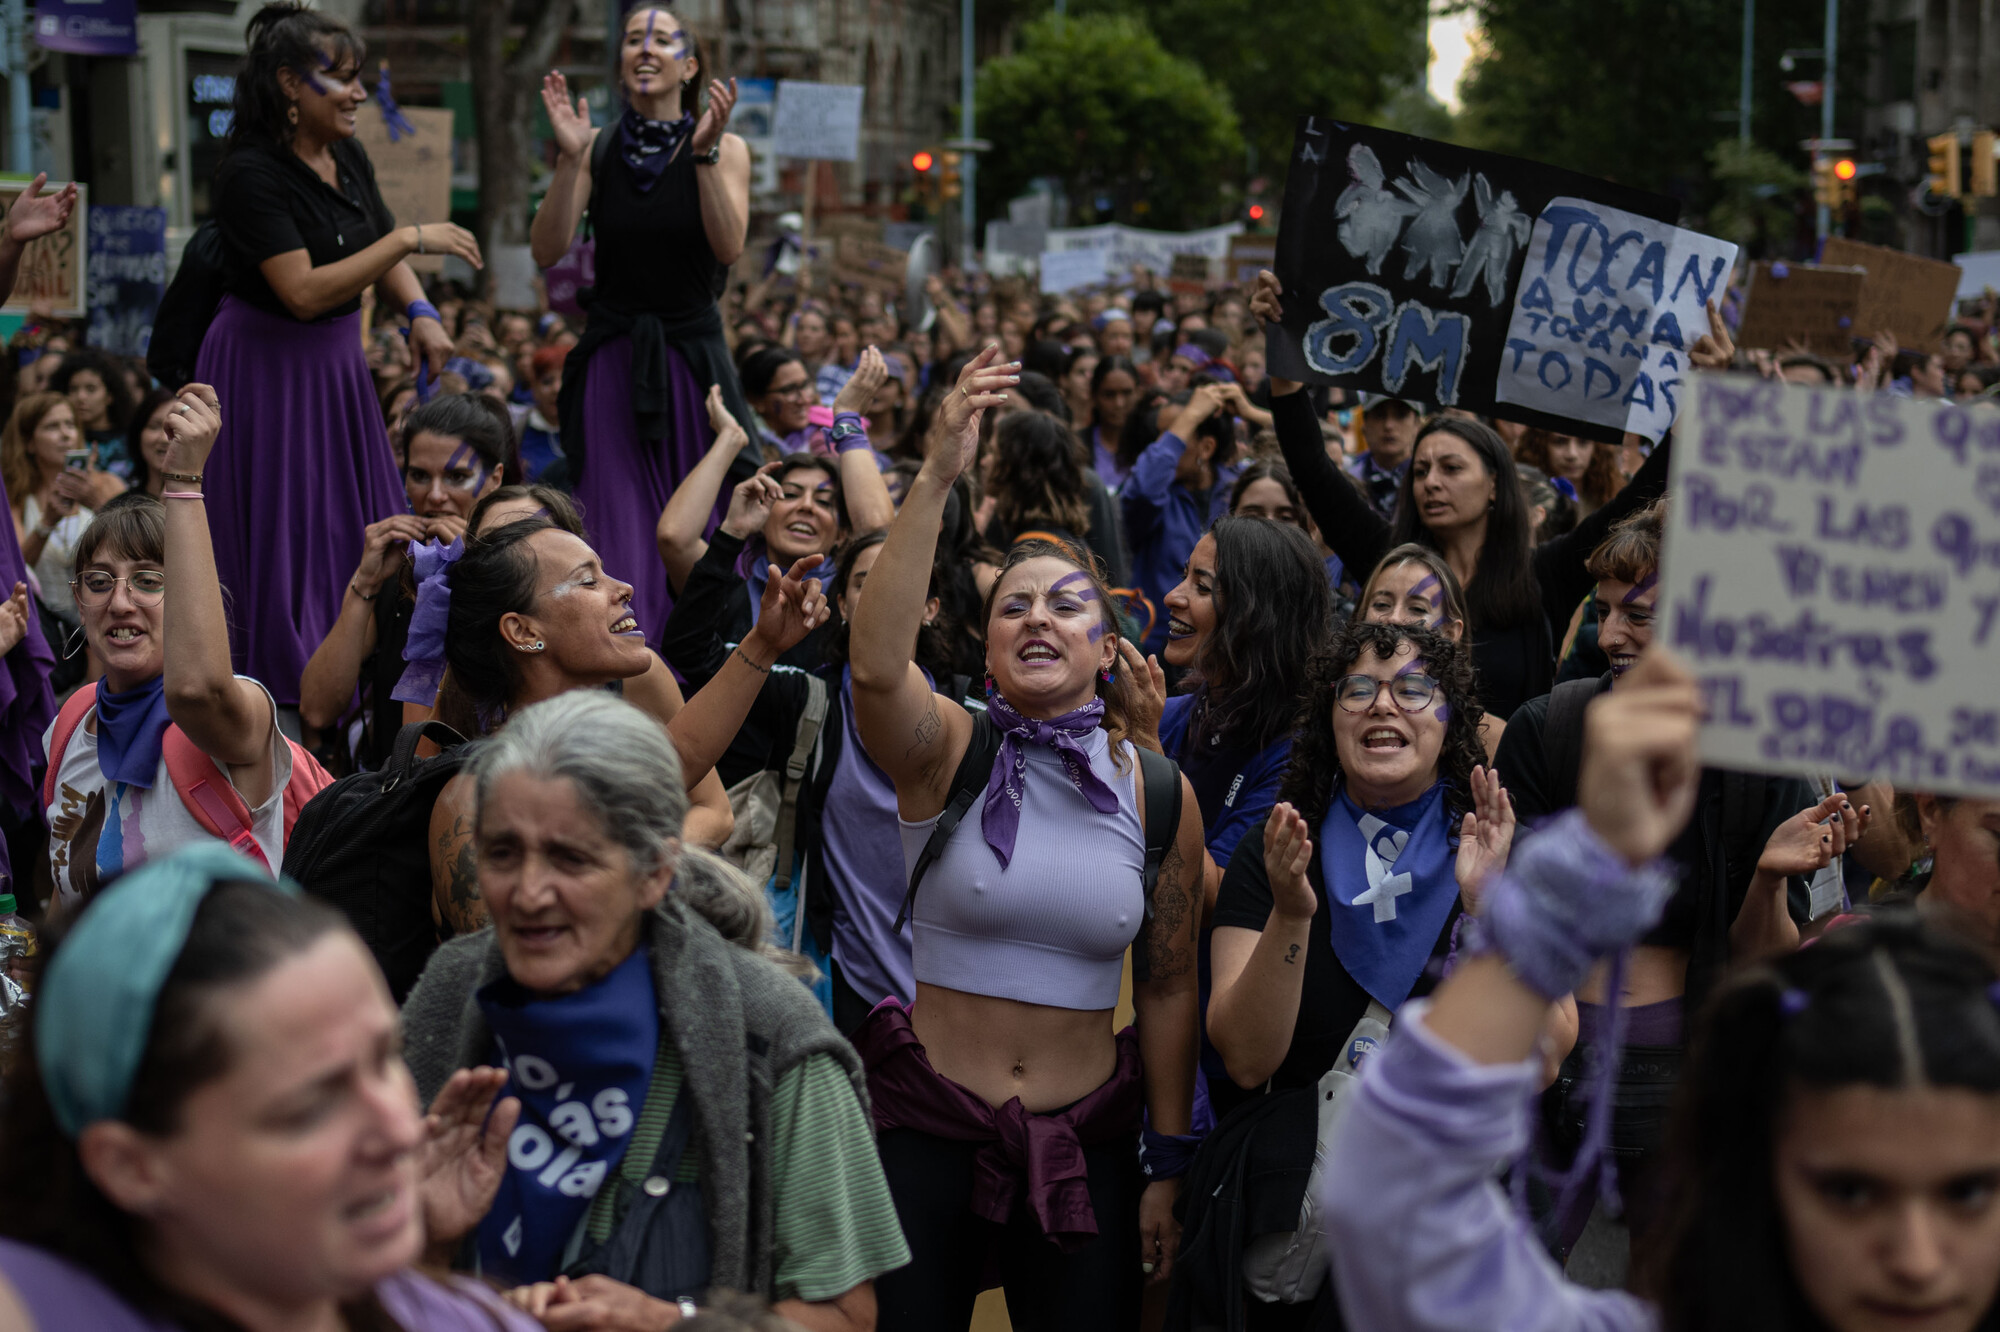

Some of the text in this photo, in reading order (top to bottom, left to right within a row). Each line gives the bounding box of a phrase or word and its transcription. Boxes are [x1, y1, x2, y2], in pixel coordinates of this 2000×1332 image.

[1540, 206, 1726, 308] TOCAN
[1303, 281, 1471, 406] 8M
[1520, 276, 1684, 349] A UNA
[1524, 312, 1648, 360] TOCAN
[1506, 338, 1686, 435] TODAS
[1805, 391, 1907, 447] LAS
[1815, 496, 1911, 552] LAS
